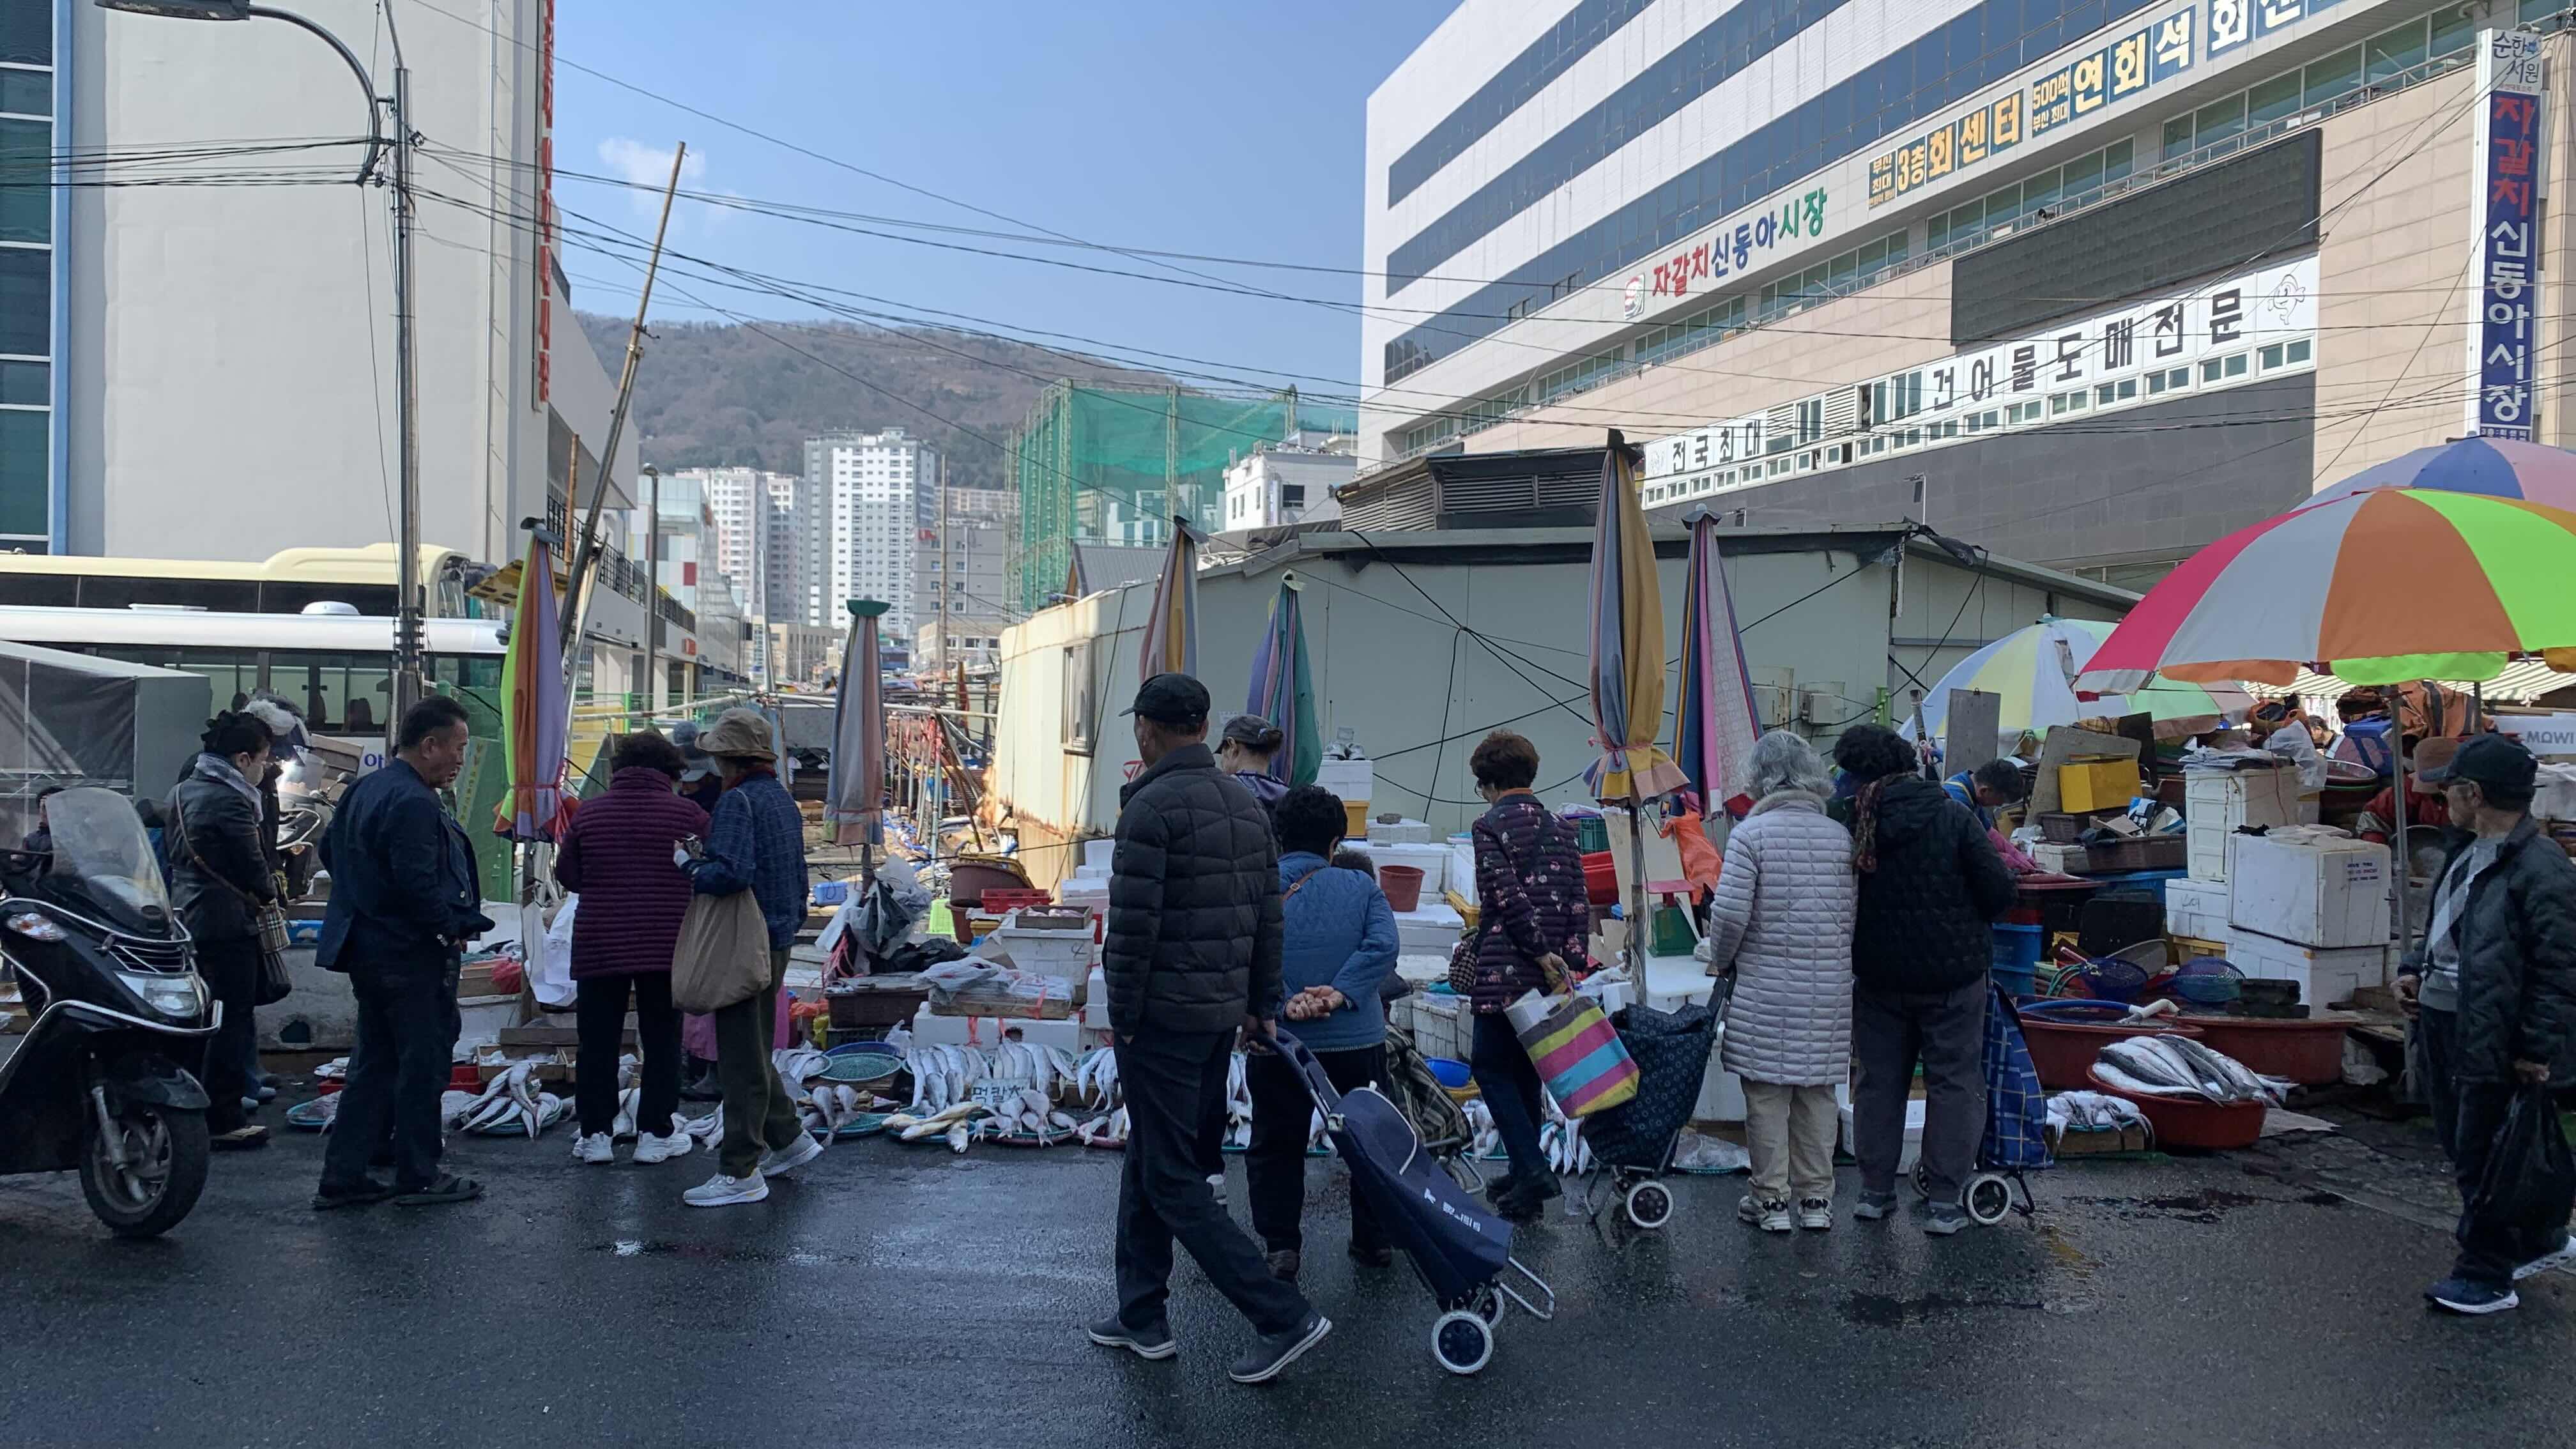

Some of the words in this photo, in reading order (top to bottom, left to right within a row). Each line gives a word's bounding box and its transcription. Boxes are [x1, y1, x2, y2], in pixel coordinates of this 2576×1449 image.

[2492, 31, 2526, 58] 순한
[2073, 10, 2190, 113] 연회석
[2033, 71, 2069, 110] 500석
[2033, 110, 2049, 132] 부산
[2051, 101, 2069, 124] 최대
[1928, 93, 2020, 178] 회센터
[1873, 154, 1892, 174] 부산
[1872, 172, 1892, 194] 최대
[2526, 730, 2574, 744] MOWI
